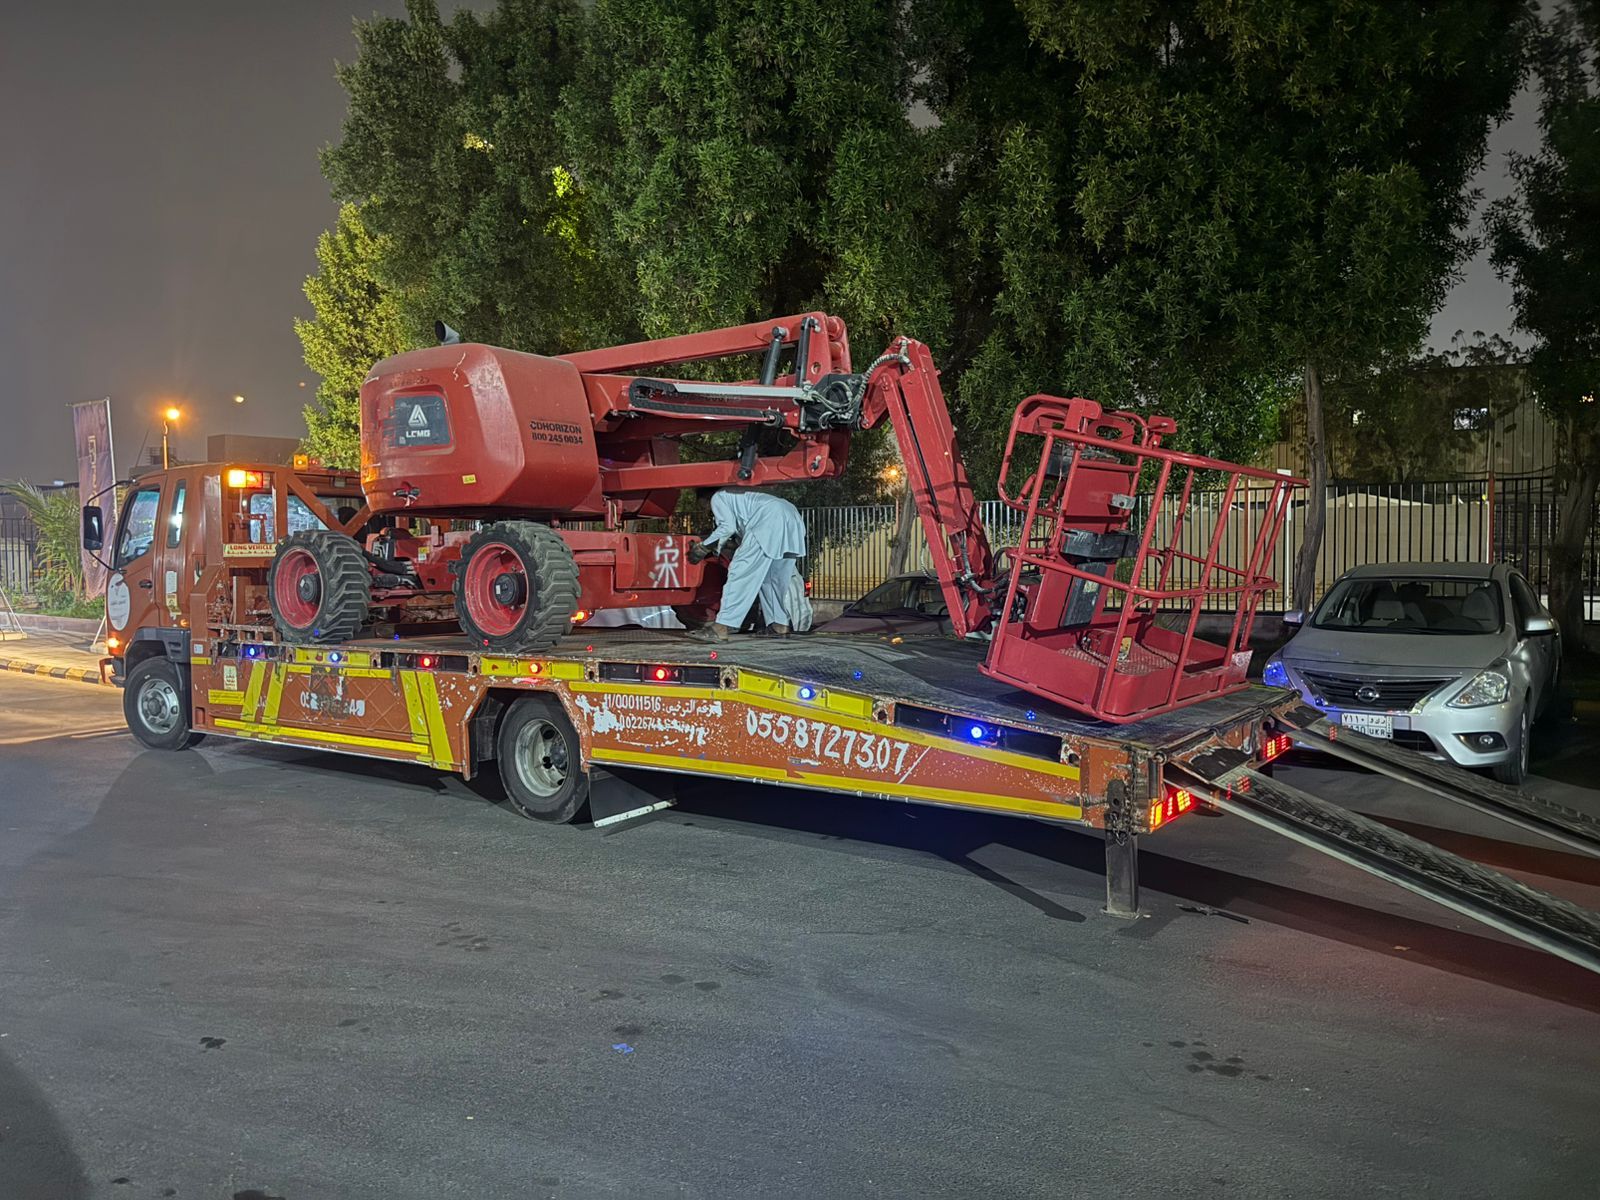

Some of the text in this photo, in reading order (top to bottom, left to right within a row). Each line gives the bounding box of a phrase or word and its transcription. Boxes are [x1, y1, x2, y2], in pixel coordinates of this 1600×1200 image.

[548, 433, 563, 443] 245
[564, 435, 583, 445] 0034
[1369, 728, 1386, 736] UKR
[746, 707, 910, 776] 0558727307
